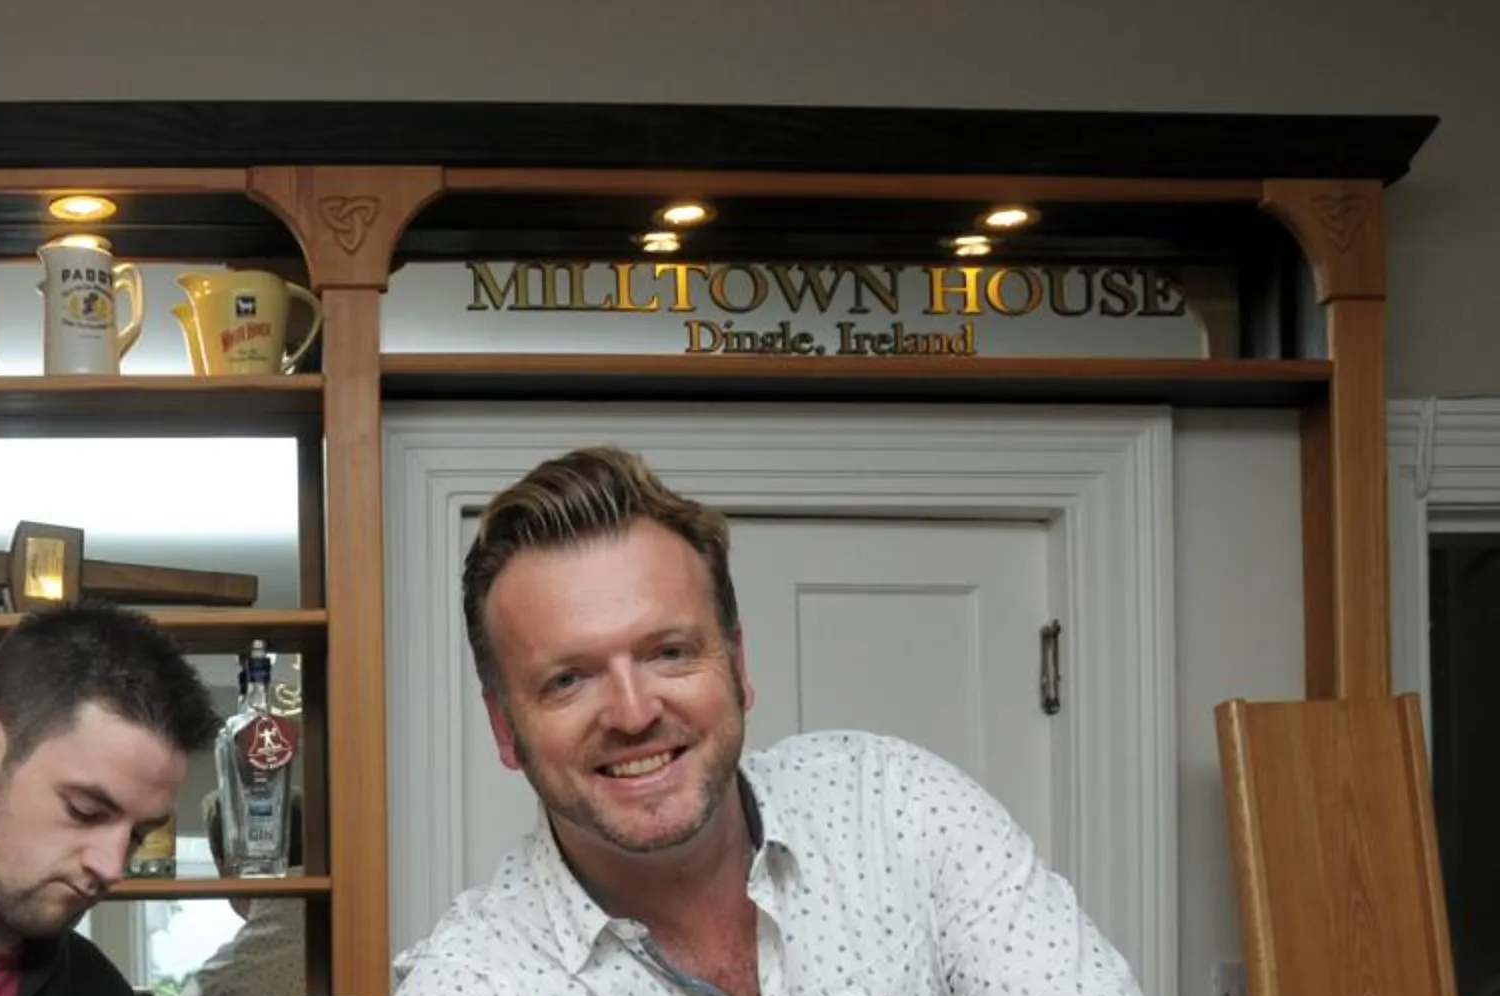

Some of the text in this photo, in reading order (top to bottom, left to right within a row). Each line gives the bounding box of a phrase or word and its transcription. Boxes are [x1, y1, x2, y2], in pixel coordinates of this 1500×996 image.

[466, 261, 1187, 318] MILLTOWN HOUSE
[836, 321, 977, 356] Ireland
